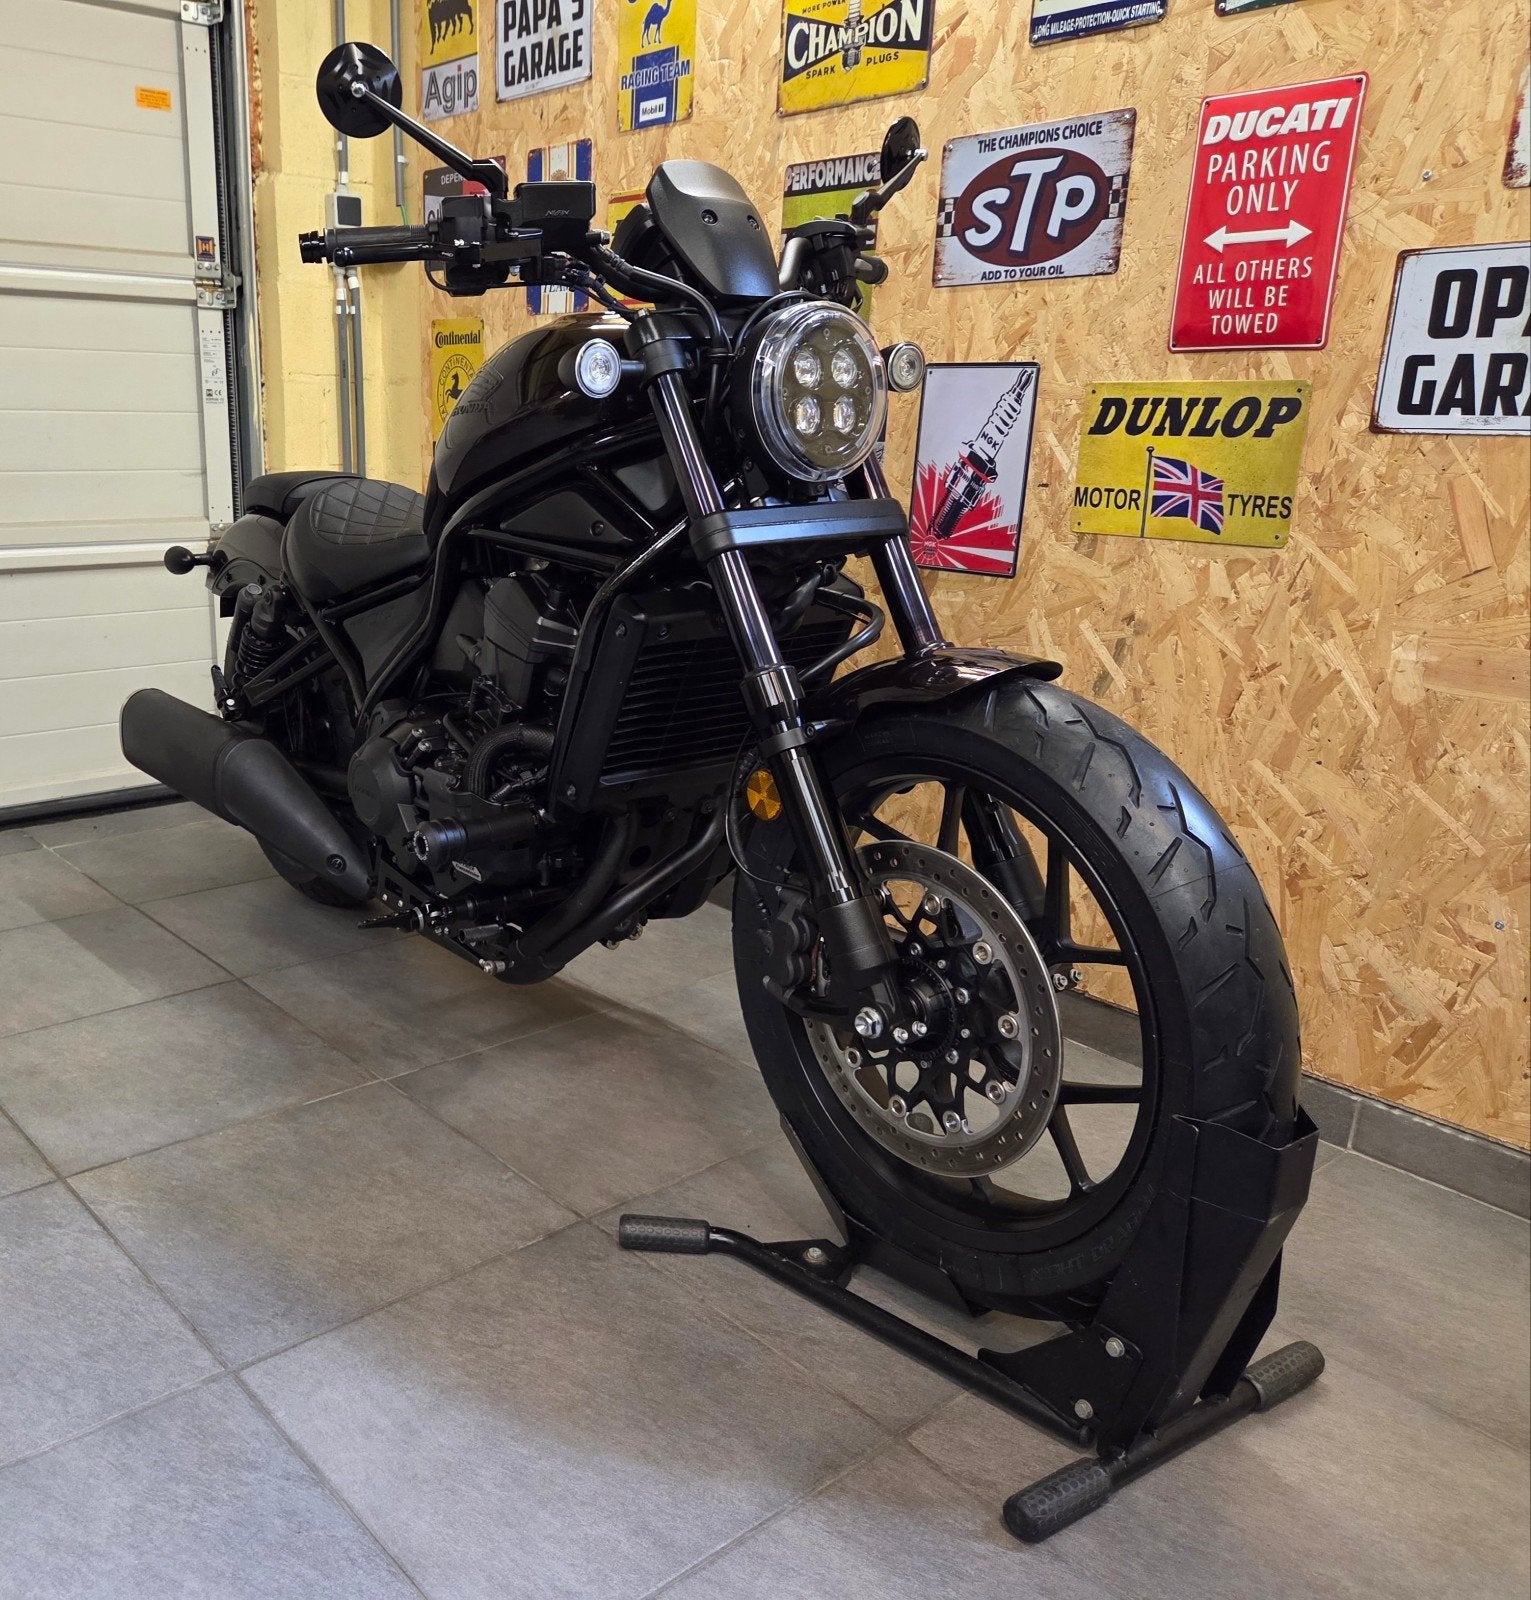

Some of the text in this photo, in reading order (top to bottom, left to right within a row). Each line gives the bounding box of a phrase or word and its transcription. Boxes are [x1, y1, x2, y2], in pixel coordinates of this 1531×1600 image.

[504, 0, 583, 43] PAPAS
[802, 3, 821, 15] MORE
[1034, 23, 1050, 38] LONG
[1130, 0, 1161, 19] STARTING
[787, 0, 924, 69] CHAMPION
[504, 29, 584, 88] GARAGE
[620, 59, 691, 91] RACING TEAM
[805, 51, 900, 80] SPARK PLUGS
[424, 64, 478, 113] Agip
[641, 105, 658, 116] Mobil
[1202, 97, 1353, 145] DUCATI
[978, 120, 1103, 154] THE CHAMPIONS CHOICE
[784, 153, 882, 191] PERFORMANCE
[1206, 140, 1332, 184] PARKING
[964, 154, 1097, 253] STP
[1226, 179, 1300, 216] ONLY
[980, 265, 1065, 282] ADD TO YOUR OIL
[1192, 256, 1314, 285] ALL OTHERS
[1208, 285, 1289, 310] WILL BE
[1427, 265, 1530, 339] OP
[435, 330, 481, 349] Continental
[1210, 312, 1279, 335] TOWED
[1397, 352, 1530, 416] GAR
[1087, 396, 1303, 438] DUNLOP
[980, 430, 1000, 451] NGK
[1073, 486, 1293, 519] MOTOR TYRES
